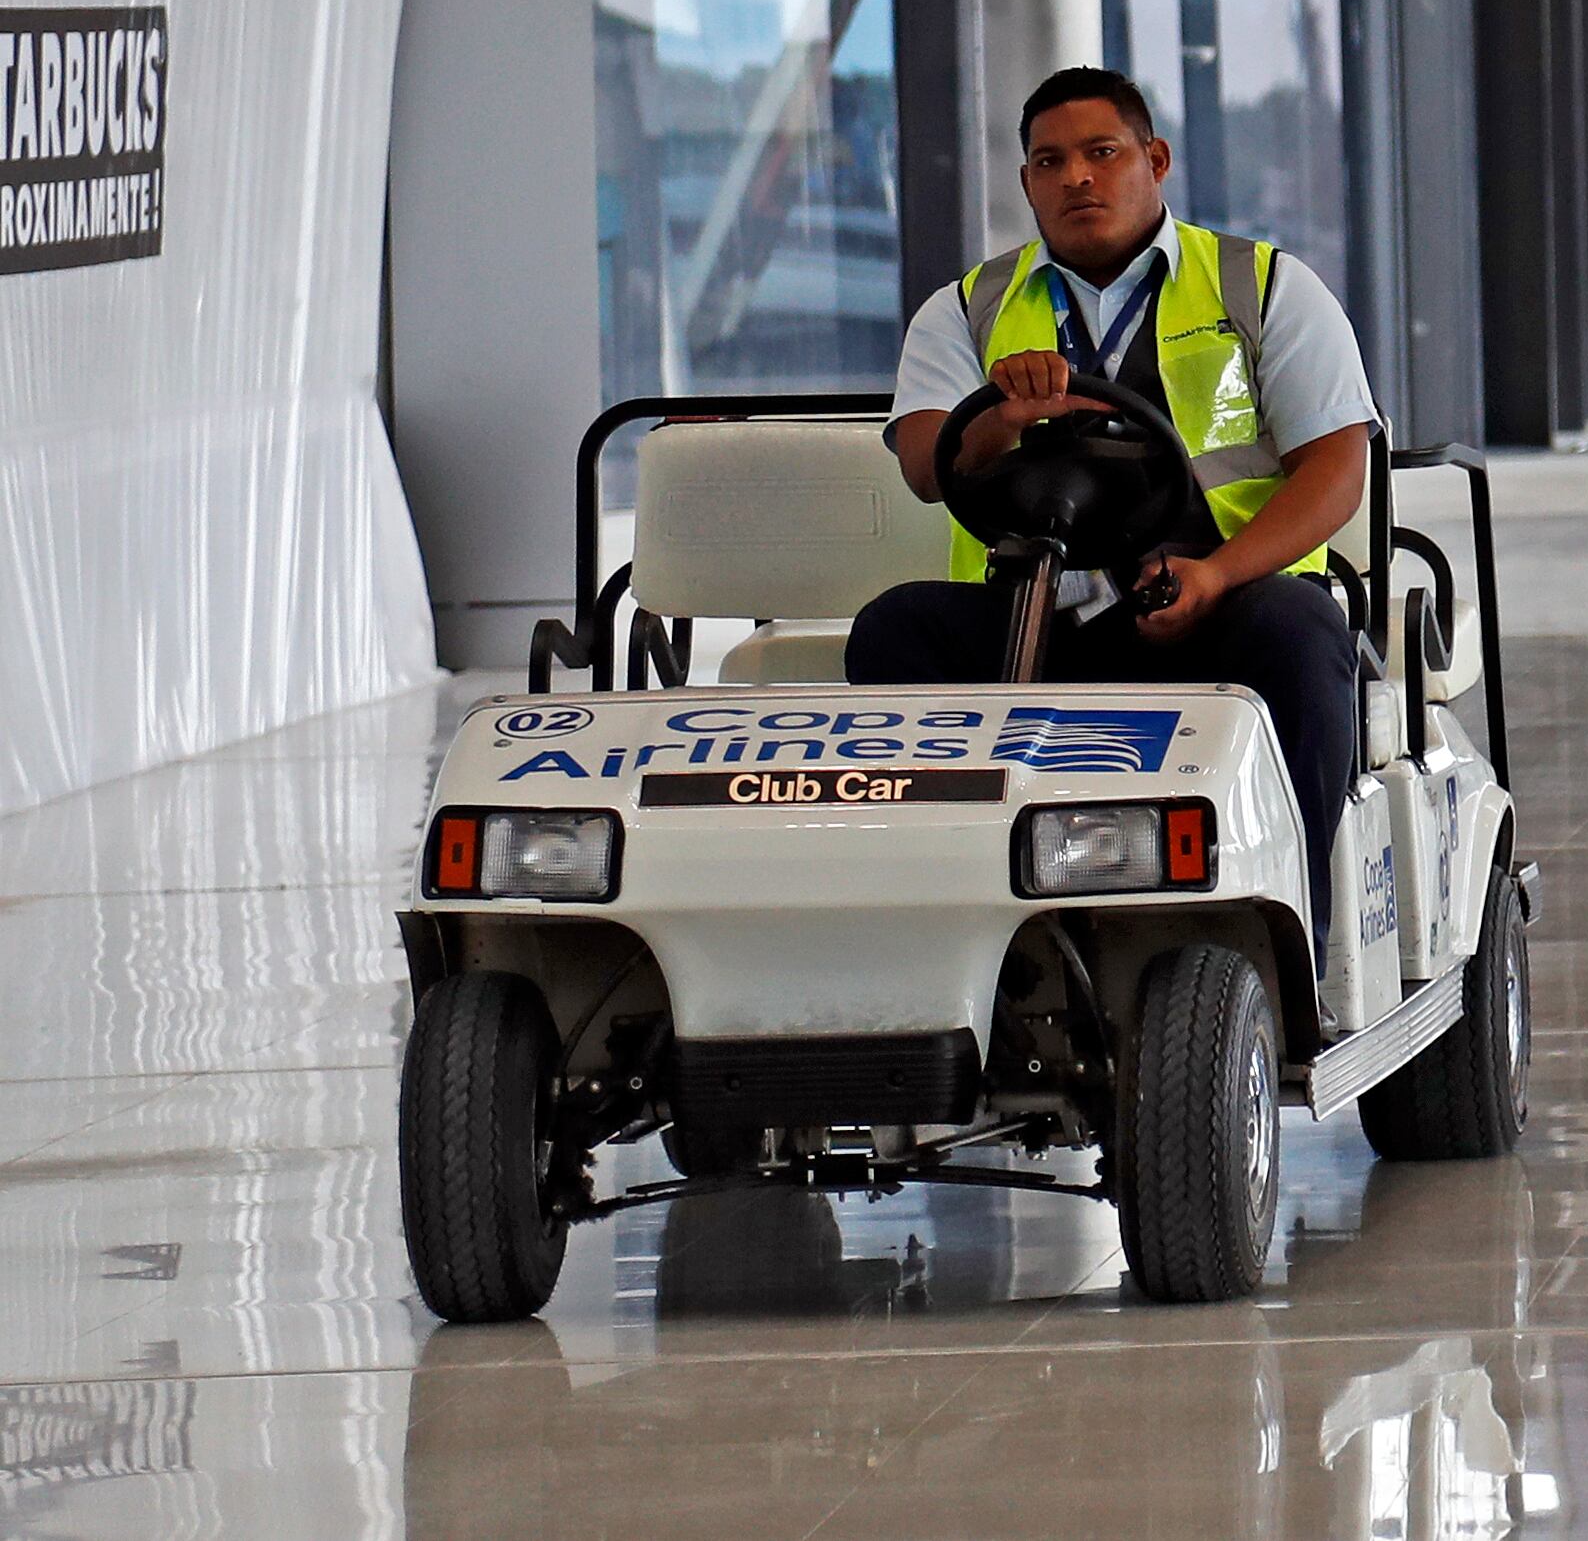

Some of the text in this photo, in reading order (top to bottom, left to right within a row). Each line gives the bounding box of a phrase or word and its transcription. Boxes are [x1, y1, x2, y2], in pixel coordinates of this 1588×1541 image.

[505, 710, 581, 733] 02
[666, 708, 984, 735] Copa
[498, 735, 970, 781] Airlines
[728, 771, 912, 804] Club Car
[1363, 855, 1384, 900] Copa
